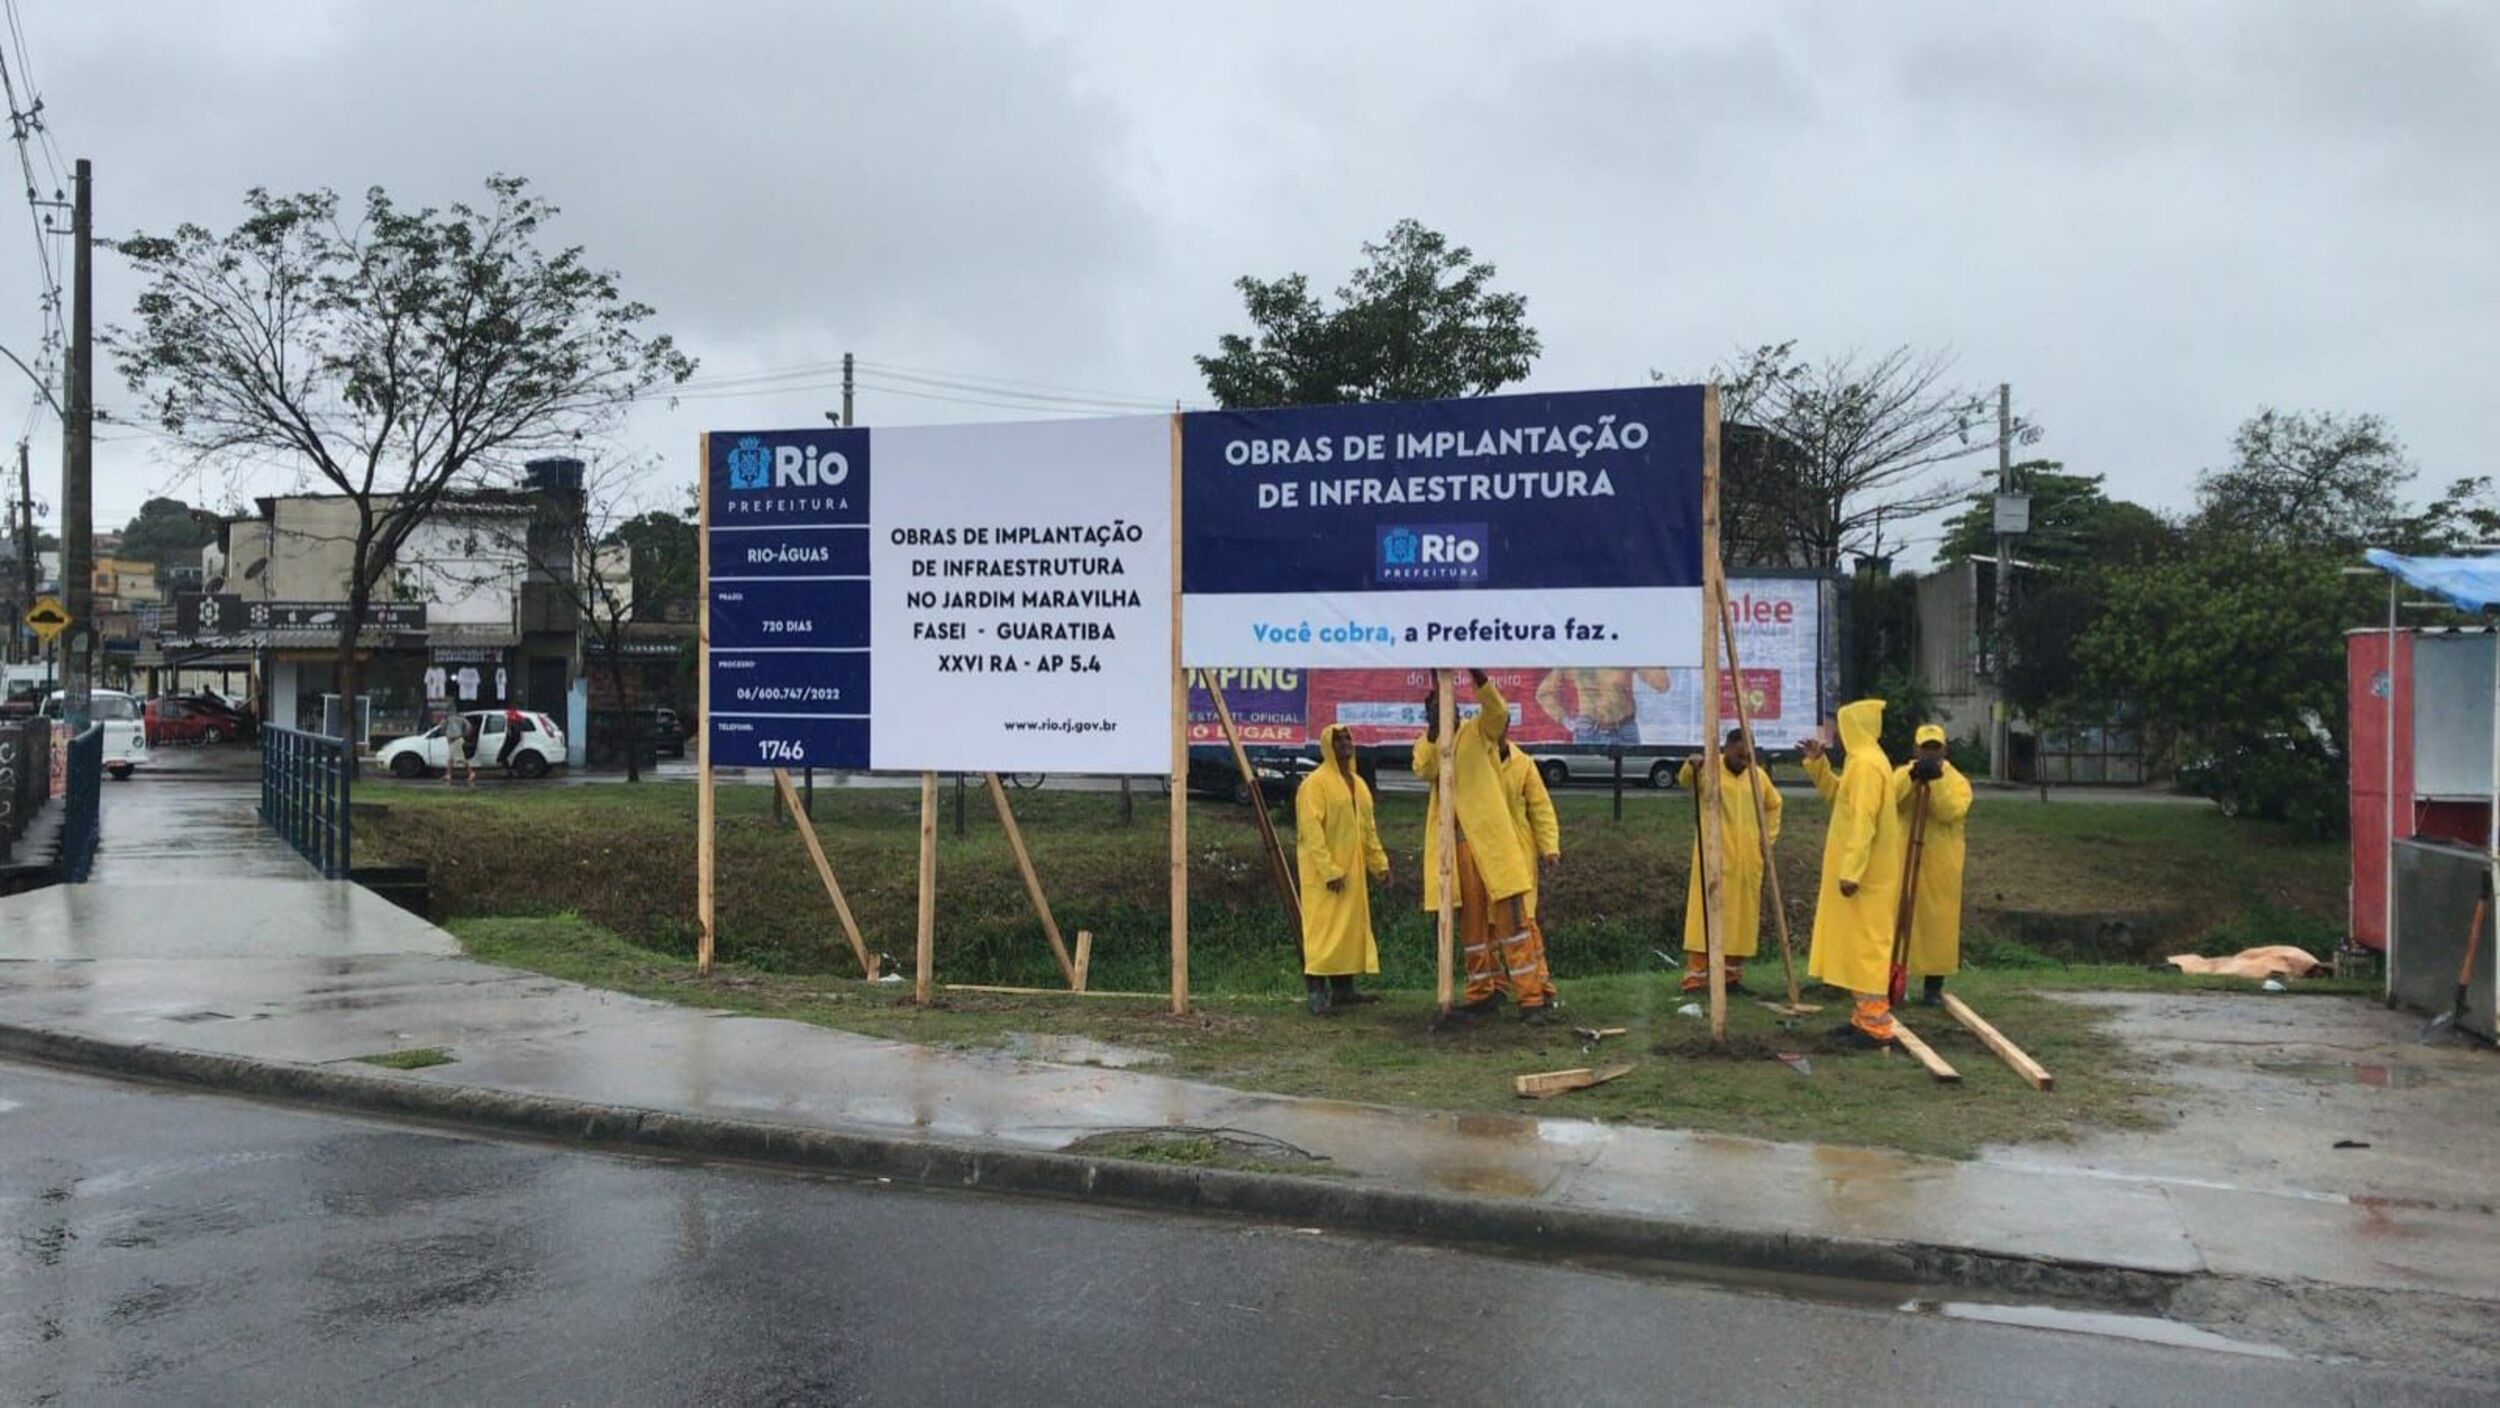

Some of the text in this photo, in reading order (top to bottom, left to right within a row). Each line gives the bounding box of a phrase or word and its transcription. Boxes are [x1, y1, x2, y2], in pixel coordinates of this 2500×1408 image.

[1224, 415, 1650, 465] OBRAS DE IMPLANTAÇÃO
[775, 444, 849, 487] Rio
[1258, 469, 1616, 509] DE INFRAESTRUTURA
[728, 497, 848, 513] PREFEITURA
[890, 519, 1143, 548] OBRAS DE IMPLANTAÇÃO
[747, 543, 829, 563] RIO-ÁGUAS
[1421, 534, 1480, 563] Rio
[911, 557, 1125, 577] DE INFRAESTRUTURA
[1384, 568, 1479, 578] PREFEITURA
[907, 589, 1142, 609] NO JARDIM MARAVILHA
[762, 620, 813, 633] 720 DIAS
[913, 622, 966, 640] FASEI
[996, 622, 1117, 640] GUARATIBA
[1253, 621, 1310, 643] Você
[1319, 619, 1397, 647] cobra,
[1404, 626, 1419, 642] a
[1427, 618, 1556, 642] Prefeitura
[938, 655, 984, 672] XXVI
[989, 655, 1018, 672] RA
[1036, 655, 1064, 672] AP
[1069, 655, 1102, 673] 5.4
[736, 686, 840, 701] 06/600.747/2022
[1004, 718, 1118, 733] www.rio.rj.gov.br
[1250, 711, 1299, 723] OFICIAL
[758, 739, 805, 760] 1746
